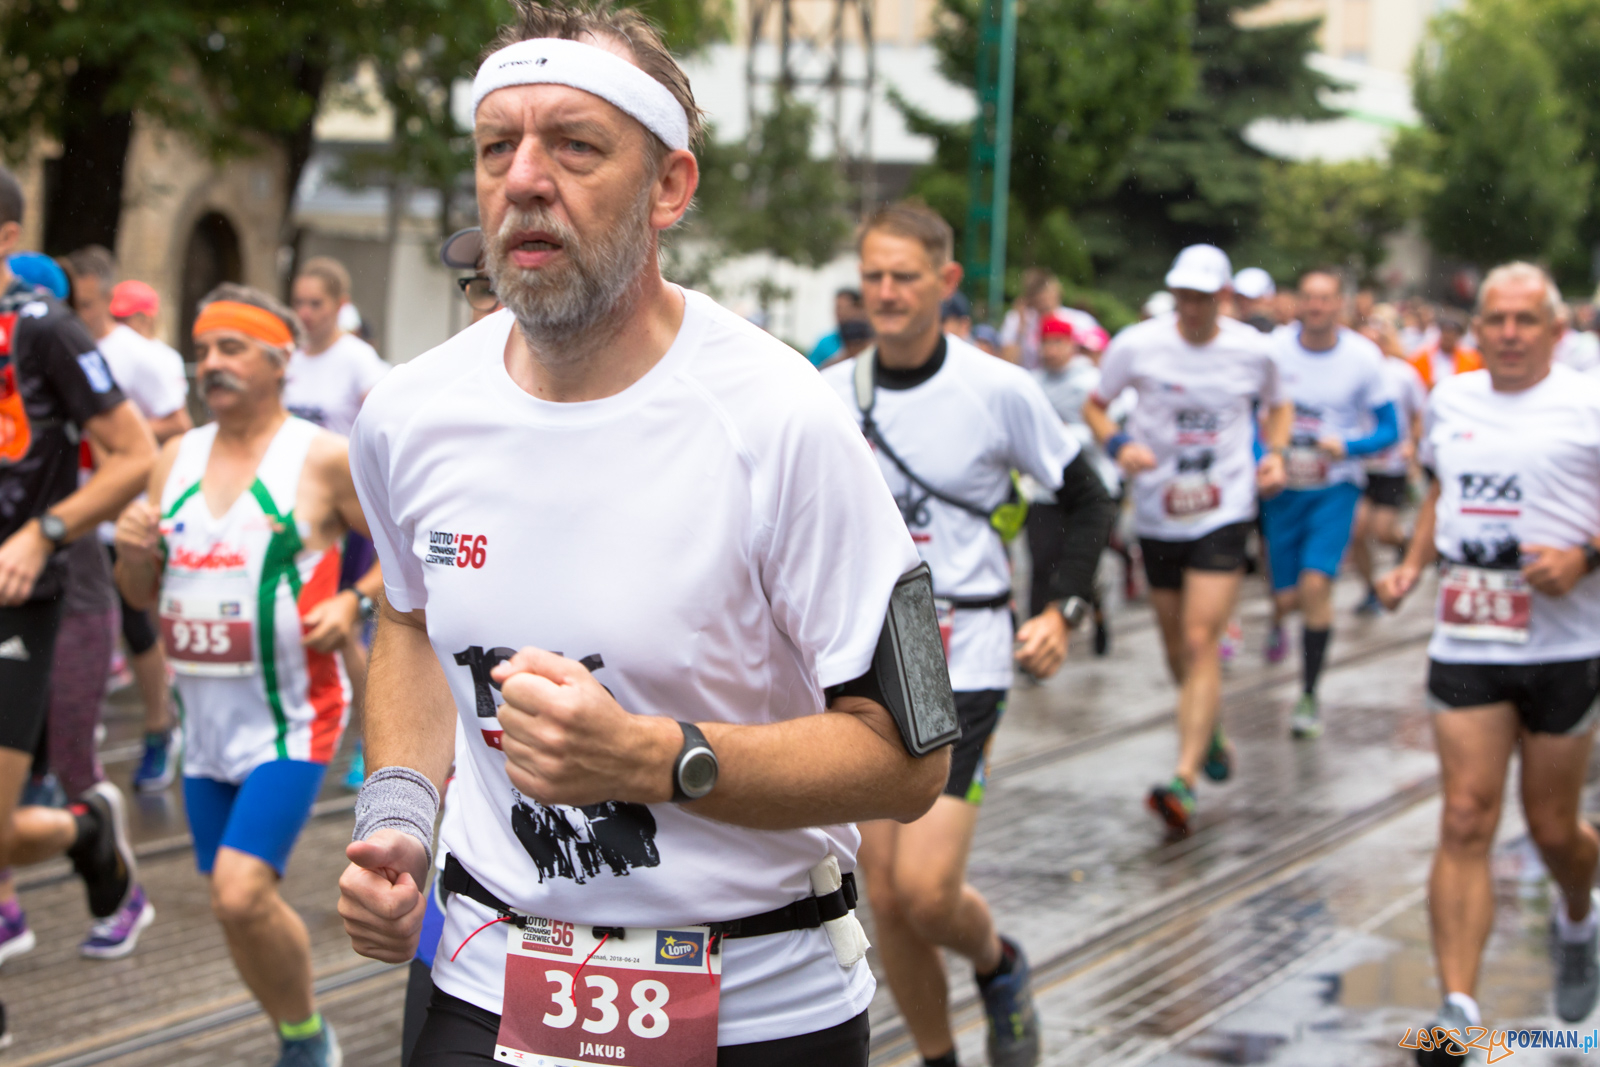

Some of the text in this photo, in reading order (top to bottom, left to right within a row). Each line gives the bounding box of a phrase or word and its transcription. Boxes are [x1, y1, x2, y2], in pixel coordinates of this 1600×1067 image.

[1458, 473, 1522, 501] 1956
[430, 530, 454, 545] LOTTO
[425, 554, 456, 566] CZERWIEC
[172, 622, 231, 654] 935
[525, 916, 548, 927] LOTTO
[522, 932, 551, 943] CZERWIEC
[668, 944, 692, 955] LOTTO
[609, 955, 640, 963] 2018-06-24
[542, 969, 670, 1039] 338
[579, 1041, 626, 1059] JAKUB
